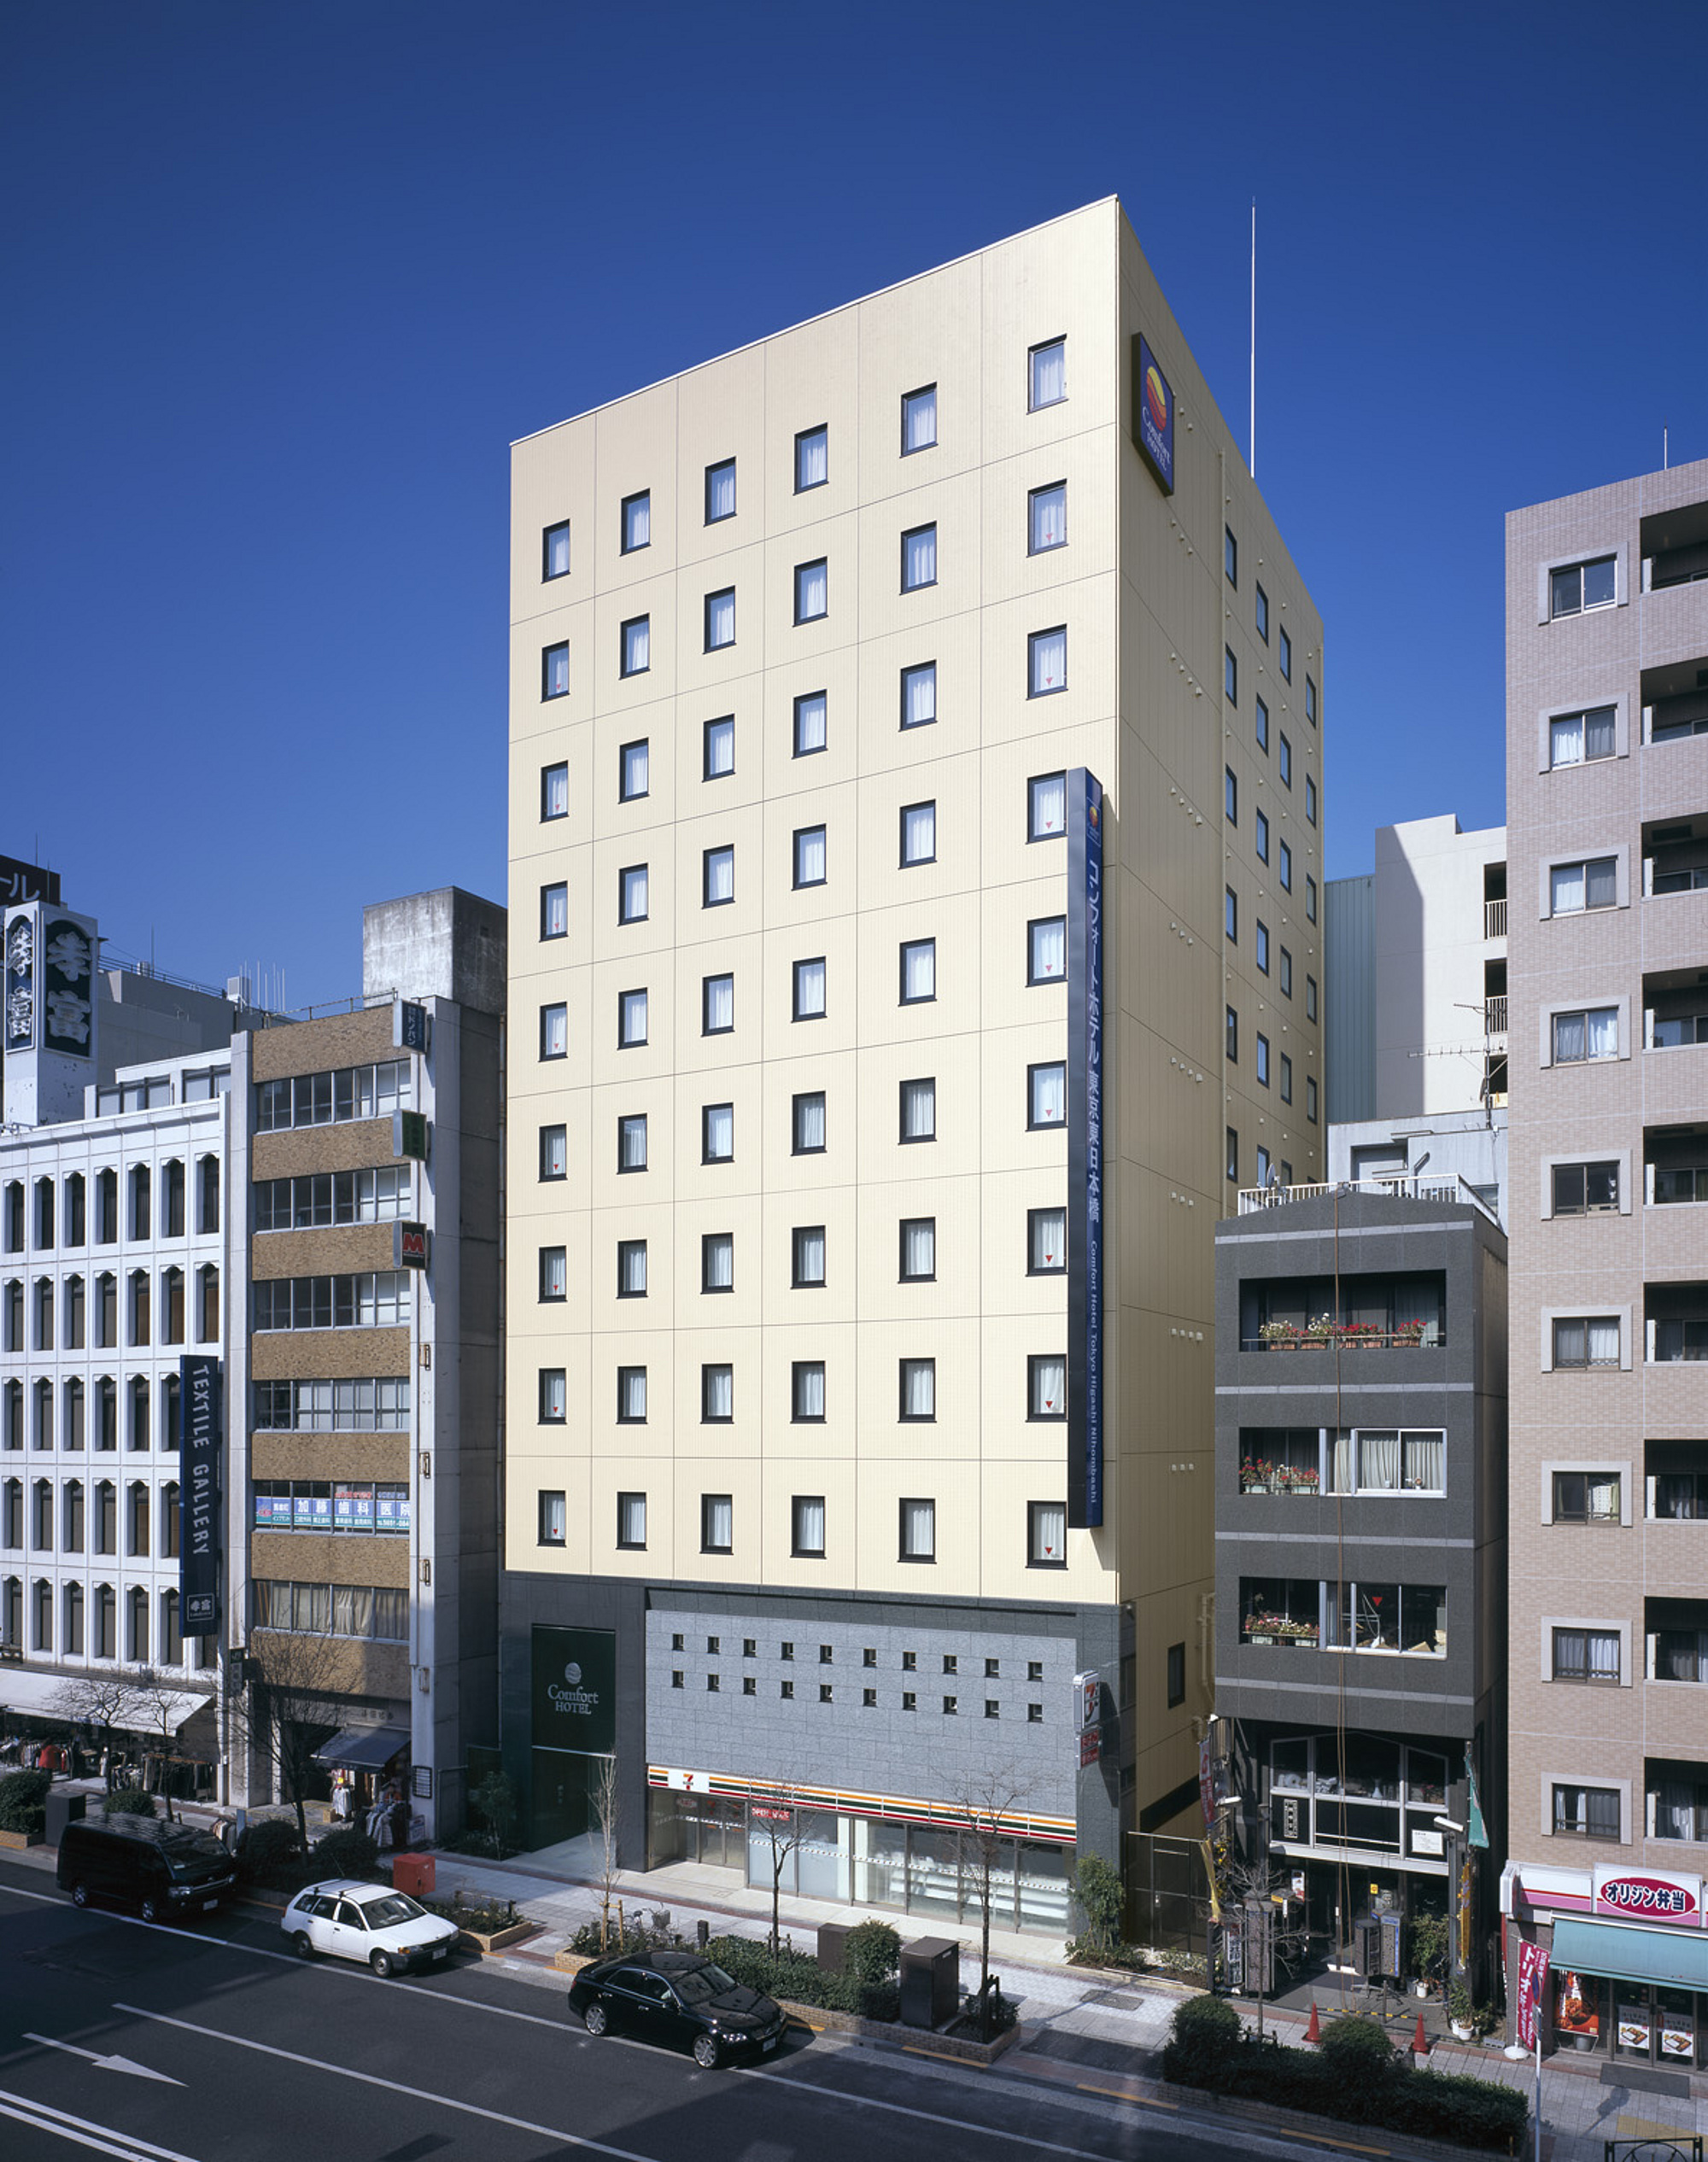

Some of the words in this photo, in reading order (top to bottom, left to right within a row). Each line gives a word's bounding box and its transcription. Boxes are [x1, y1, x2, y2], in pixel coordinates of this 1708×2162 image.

[192, 1364, 210, 1449] TEXTILE
[192, 1463, 210, 1555] GALLERY
[547, 1684, 599, 1704] Comfort
[555, 1701, 592, 1715] HOTEL
[1606, 1883, 1686, 1912] オリジン弁当
